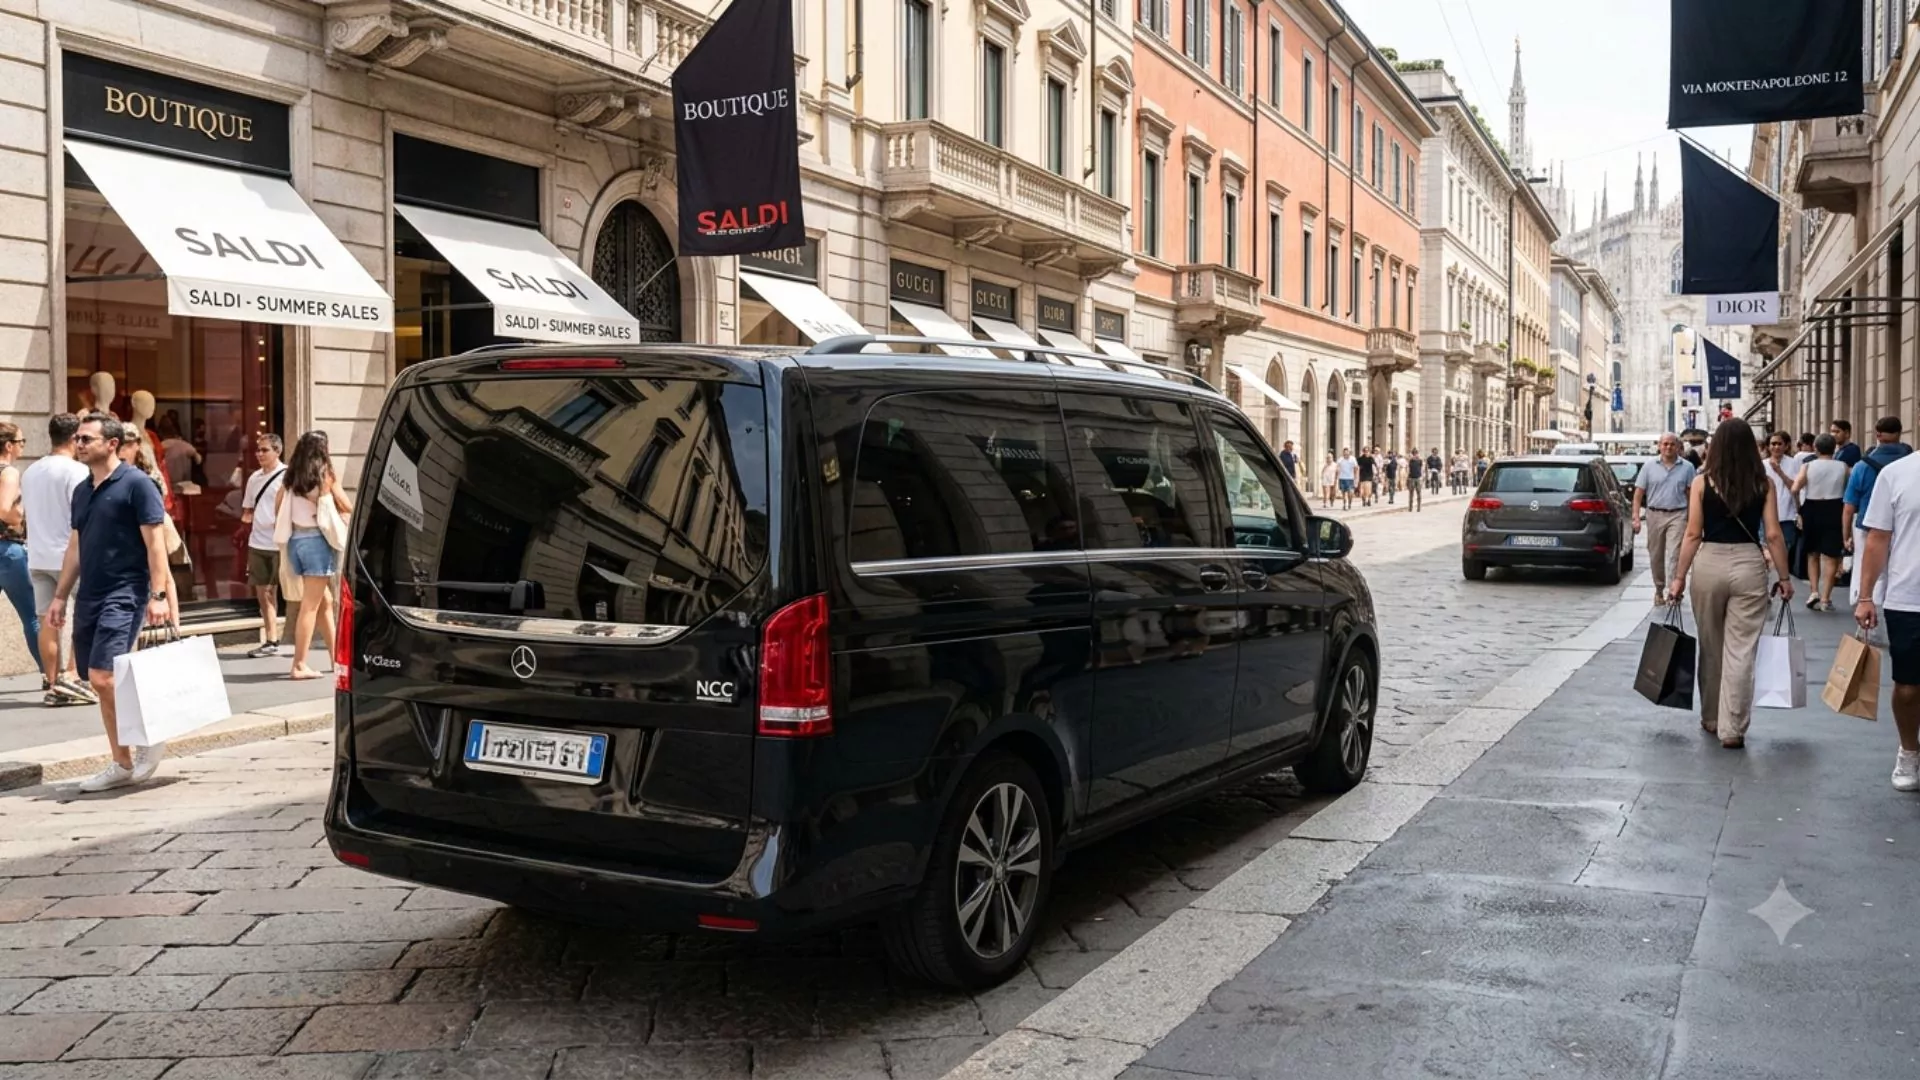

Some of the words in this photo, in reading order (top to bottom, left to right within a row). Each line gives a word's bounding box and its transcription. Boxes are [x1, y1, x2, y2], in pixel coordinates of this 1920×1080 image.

[1682, 84, 1703, 94] VIA
[1834, 70, 1848, 82] 12
[104, 85, 254, 142] BOUTIQUE
[683, 88, 789, 120] BOUTIQUE
[697, 200, 789, 234] SALDI
[175, 227, 325, 270] SALDI
[486, 268, 590, 300] SALDI
[189, 289, 241, 308] SALDI
[257, 296, 327, 316] SUMMER
[331, 303, 379, 321] SALES
[1717, 298, 1767, 314] DIOR
[505, 314, 539, 330] SALDI
[549, 319, 596, 335] SUMMER
[598, 324, 632, 340] SALES
[696, 680, 733, 697] NCC
